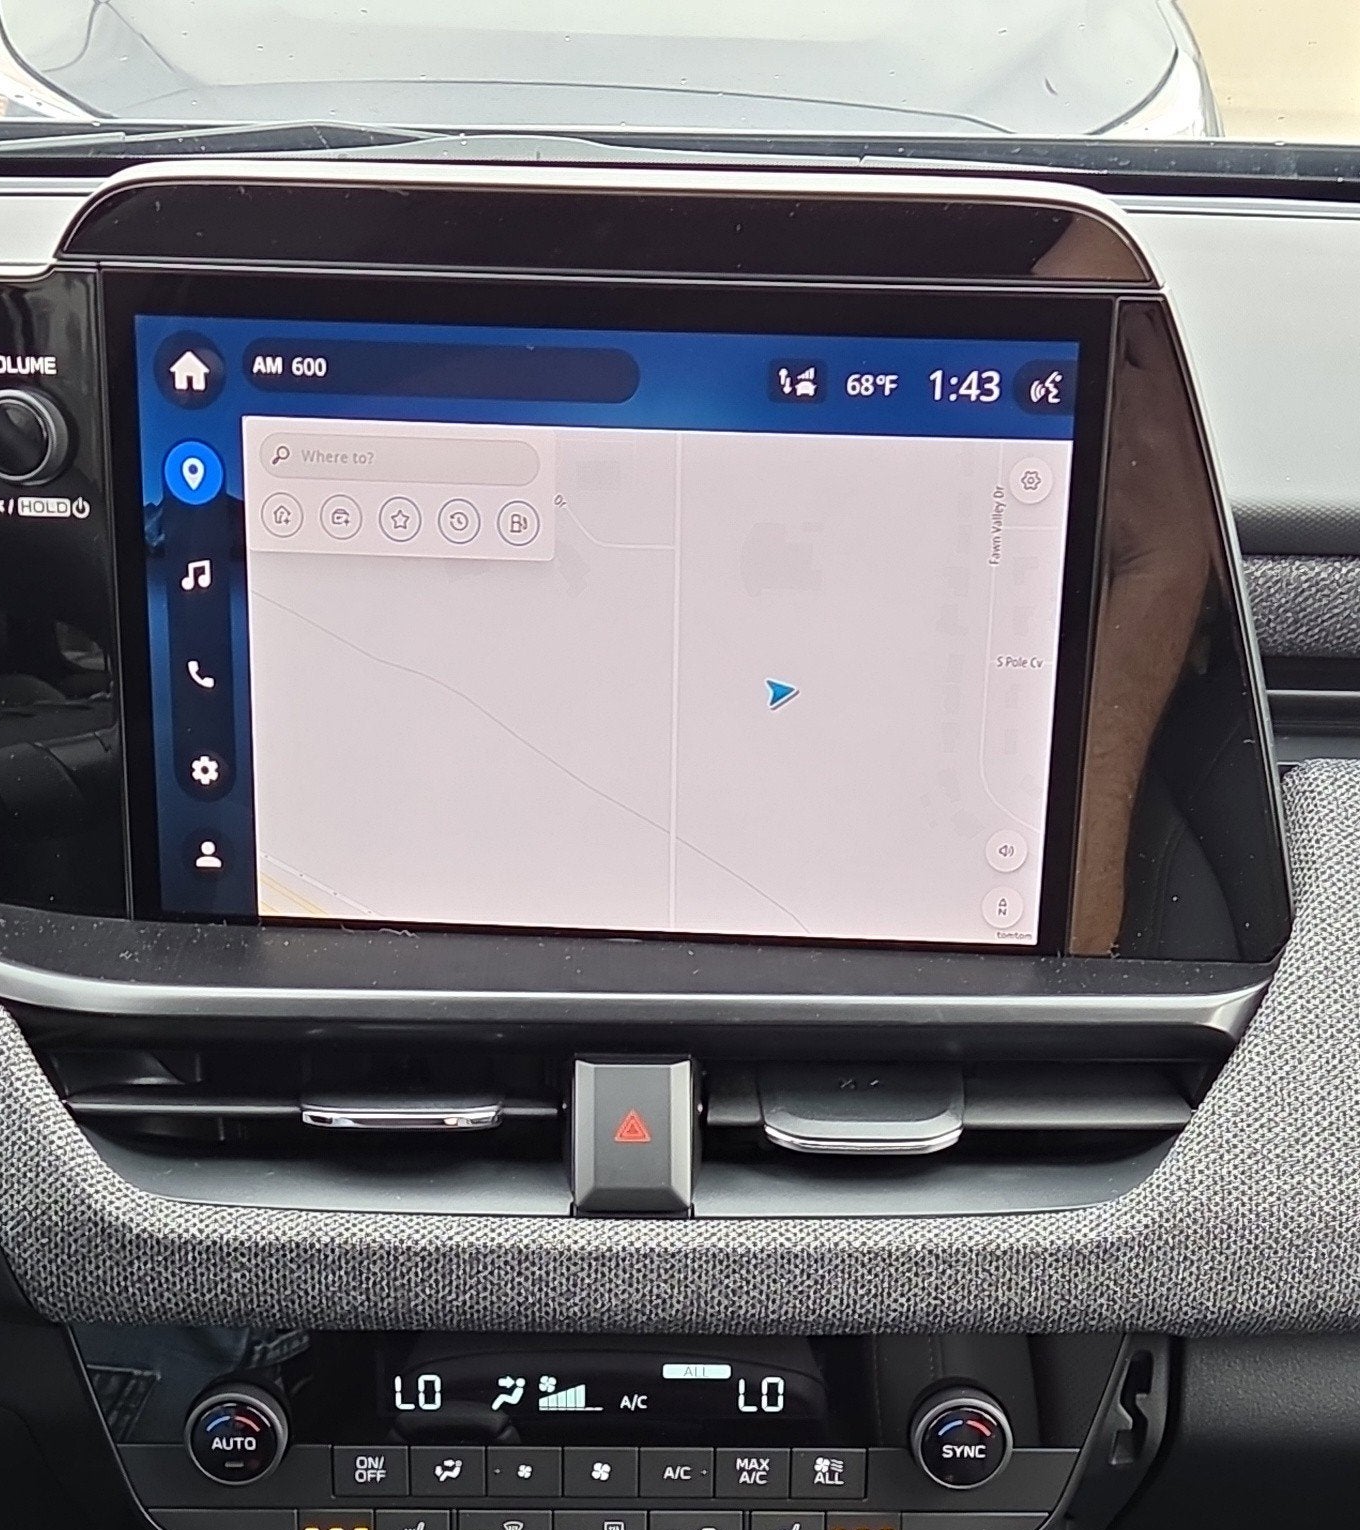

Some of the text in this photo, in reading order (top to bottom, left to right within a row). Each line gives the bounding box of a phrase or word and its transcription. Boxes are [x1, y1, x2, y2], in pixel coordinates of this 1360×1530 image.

[252, 356, 327, 377] AM 600
[846, 374, 899, 397] 68°F
[929, 369, 1001, 402] 1:43
[301, 448, 374, 466] Where to?
[19, 498, 69, 516] HOLD
[991, 500, 1007, 534] Valley
[988, 536, 1002, 565] Fawn
[996, 931, 1032, 940] tomtom
[682, 1366, 711, 1378] ALL
[620, 1394, 648, 1410] A/C
[211, 1436, 257, 1451] AUTO
[942, 1444, 986, 1459] SYNC
[355, 1456, 385, 1471] ON/
[736, 1458, 770, 1471] MAX
[355, 1469, 386, 1484] OFF
[663, 1465, 691, 1480] A/C
[739, 1471, 768, 1485] A/C
[814, 1471, 844, 1485] ALL
